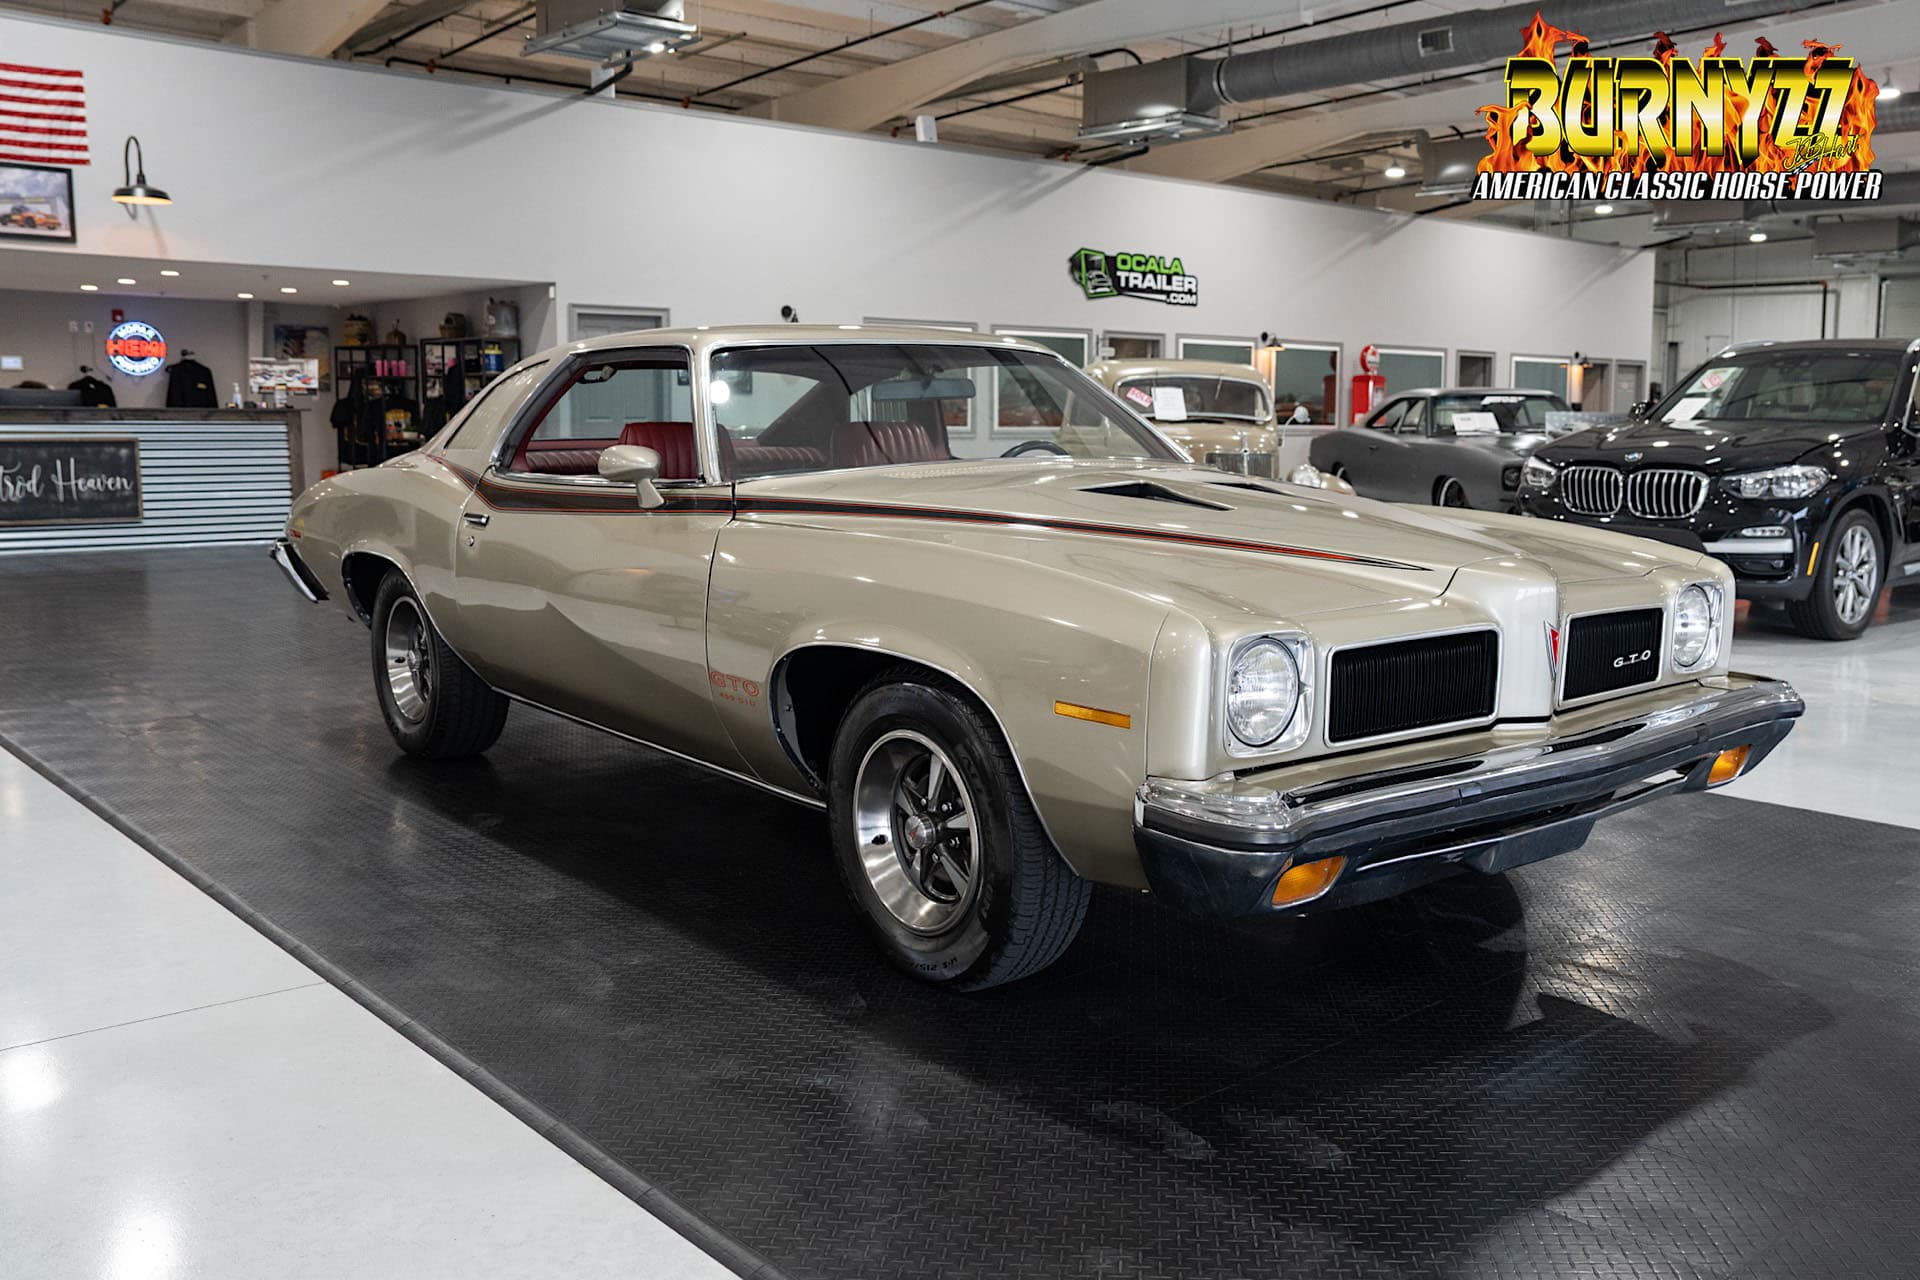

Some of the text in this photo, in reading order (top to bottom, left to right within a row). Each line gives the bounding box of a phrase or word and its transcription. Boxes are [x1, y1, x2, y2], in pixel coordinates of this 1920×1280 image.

[1116, 252, 1184, 274] OCALA
[1117, 271, 1197, 293] TRAILER
[1167, 293, 1197, 305] .COM
[106, 339, 167, 358] HEMI
[51, 457, 134, 502] Heaven
[710, 671, 760, 697] GTO
